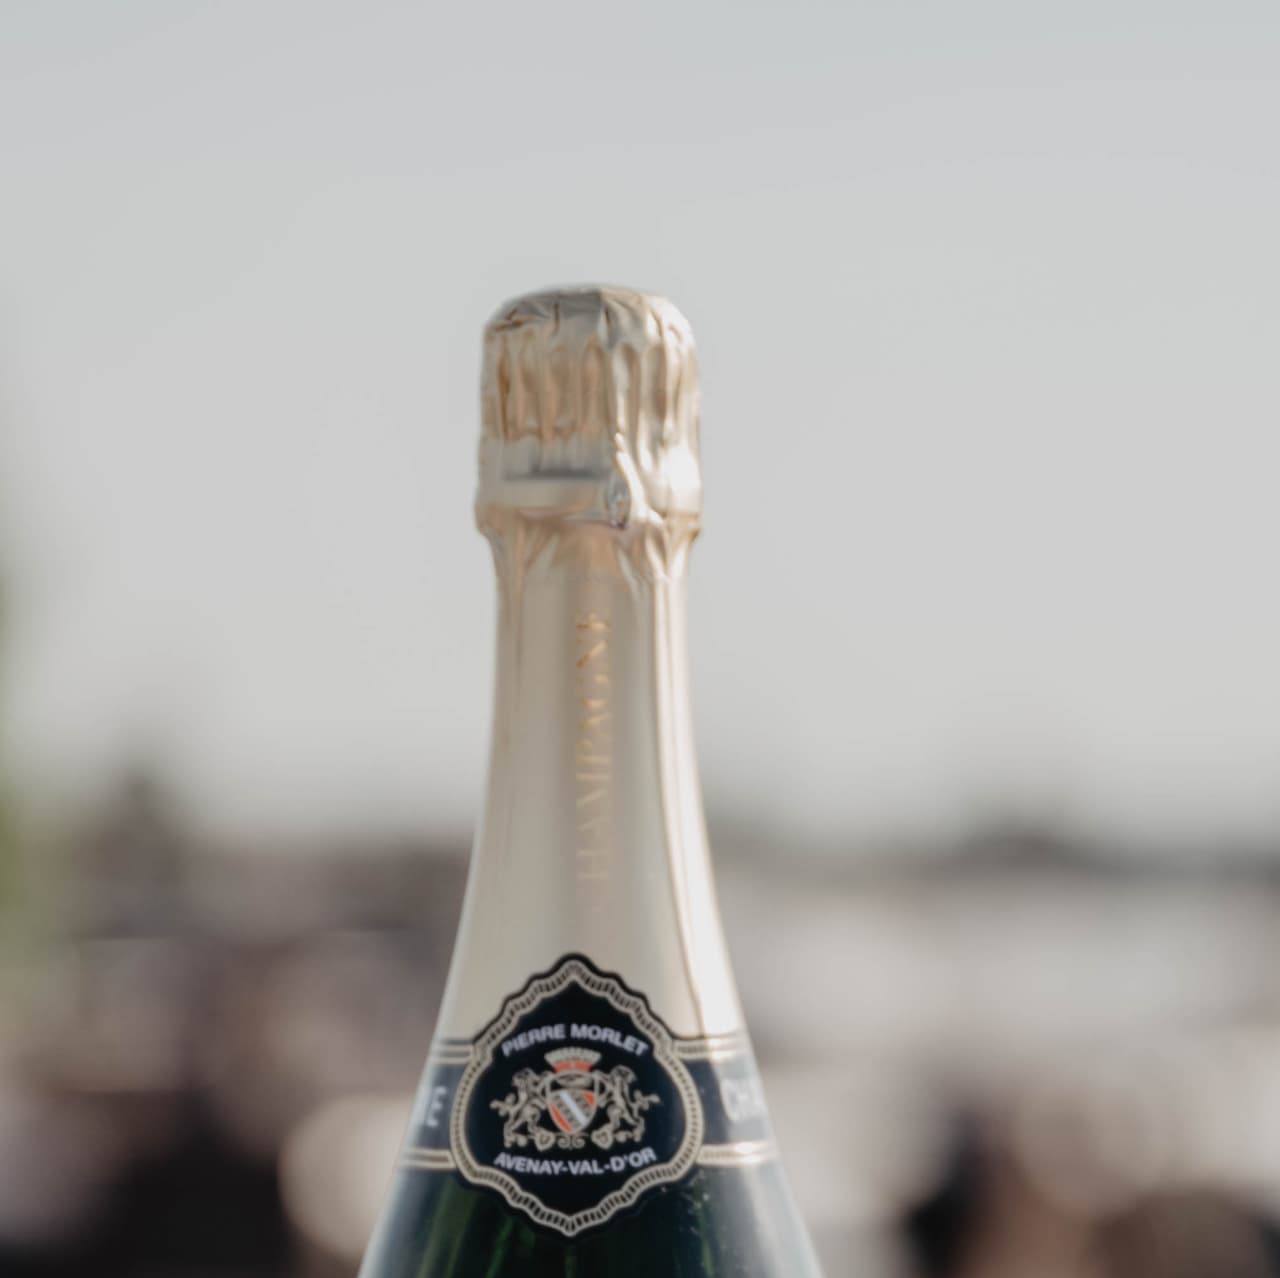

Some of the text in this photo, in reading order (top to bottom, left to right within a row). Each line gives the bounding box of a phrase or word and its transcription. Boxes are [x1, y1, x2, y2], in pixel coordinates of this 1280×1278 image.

[501, 1023, 649, 1057] PIERRE MORLET
[494, 1147, 657, 1176] AVENAY-VAL-D'OR
